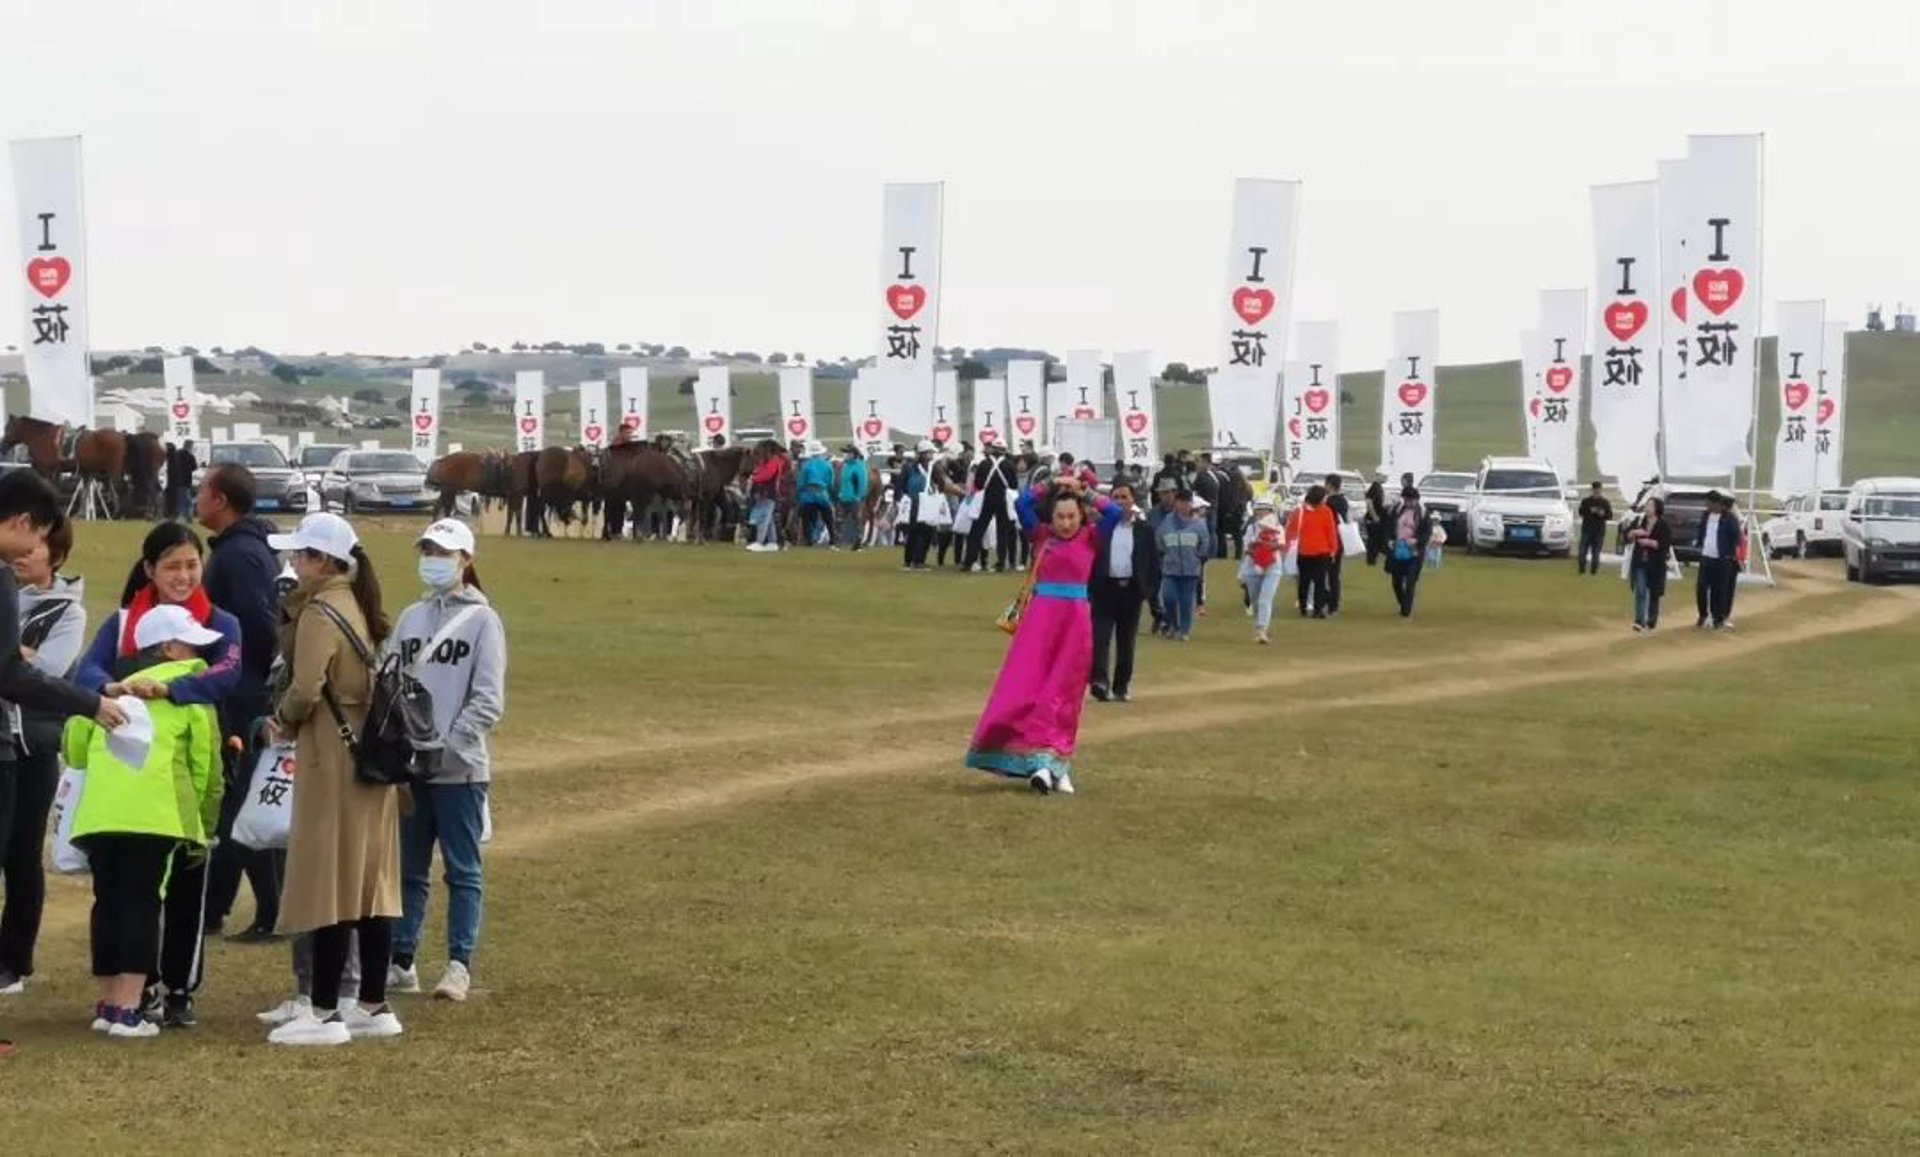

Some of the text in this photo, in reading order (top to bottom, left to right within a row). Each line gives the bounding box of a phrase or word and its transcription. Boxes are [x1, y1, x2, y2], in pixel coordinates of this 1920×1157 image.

[401, 638, 420, 667] IP
[270, 756, 283, 772] I
[259, 776, 292, 806] 莜
